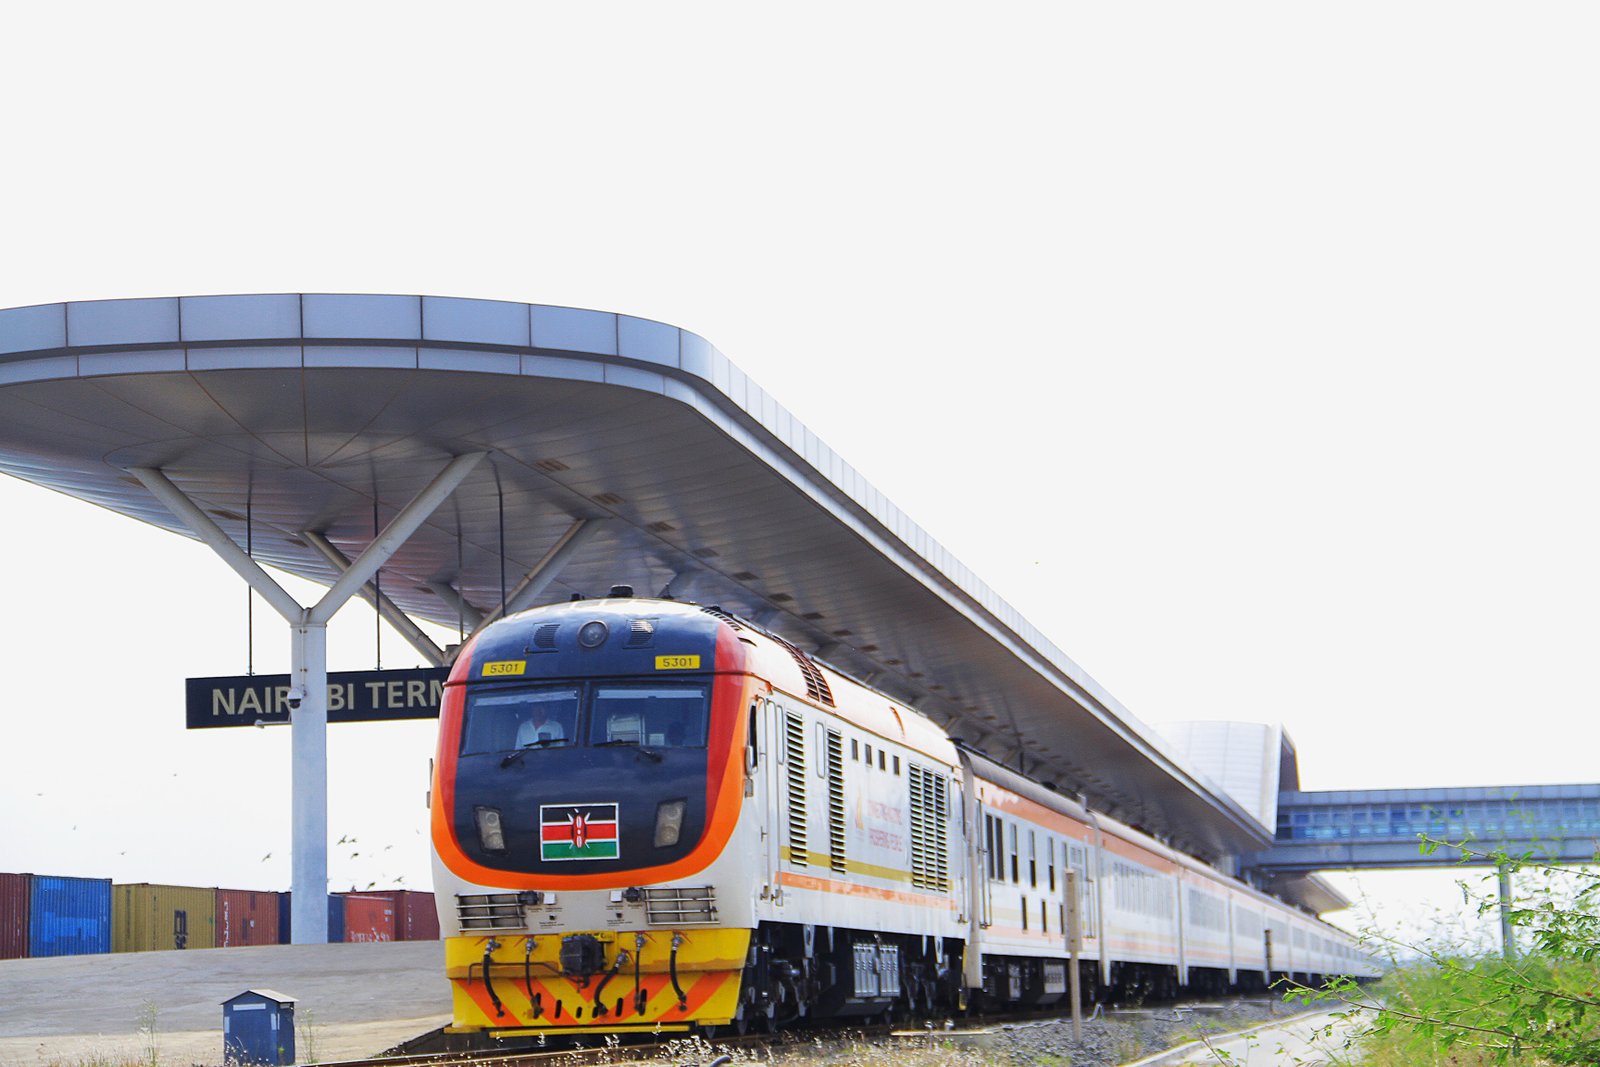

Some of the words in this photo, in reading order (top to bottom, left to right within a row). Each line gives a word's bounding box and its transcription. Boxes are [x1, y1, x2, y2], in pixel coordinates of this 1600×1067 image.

[662, 657, 692, 667] 5301
[490, 663, 519, 673] 5301
[212, 683, 354, 716] NAIRBI
